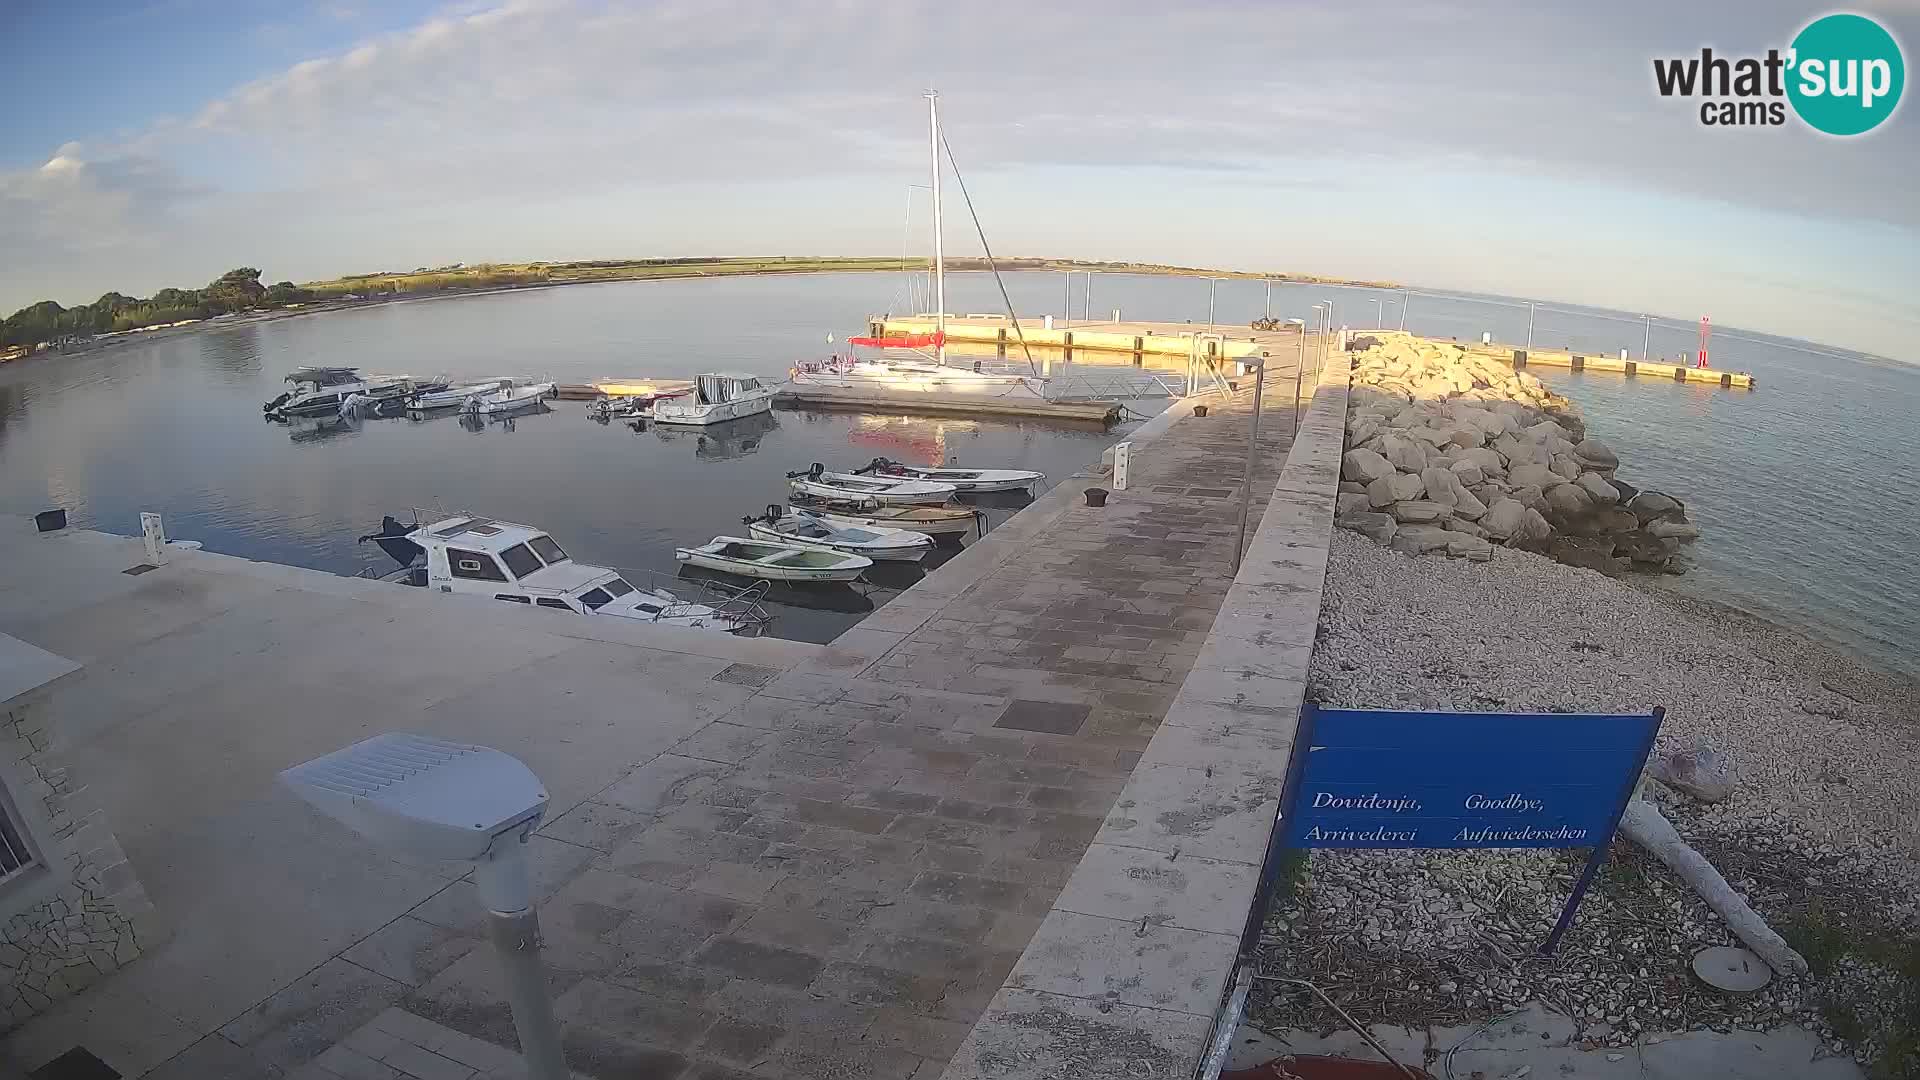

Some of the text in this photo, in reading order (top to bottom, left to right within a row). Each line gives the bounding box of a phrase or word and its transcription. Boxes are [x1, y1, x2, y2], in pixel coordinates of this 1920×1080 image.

[1465, 793, 1544, 812] Goodbye,
[1304, 825, 1418, 841] Arrivederci
[1453, 825, 1587, 843] Aufwiedersehen
